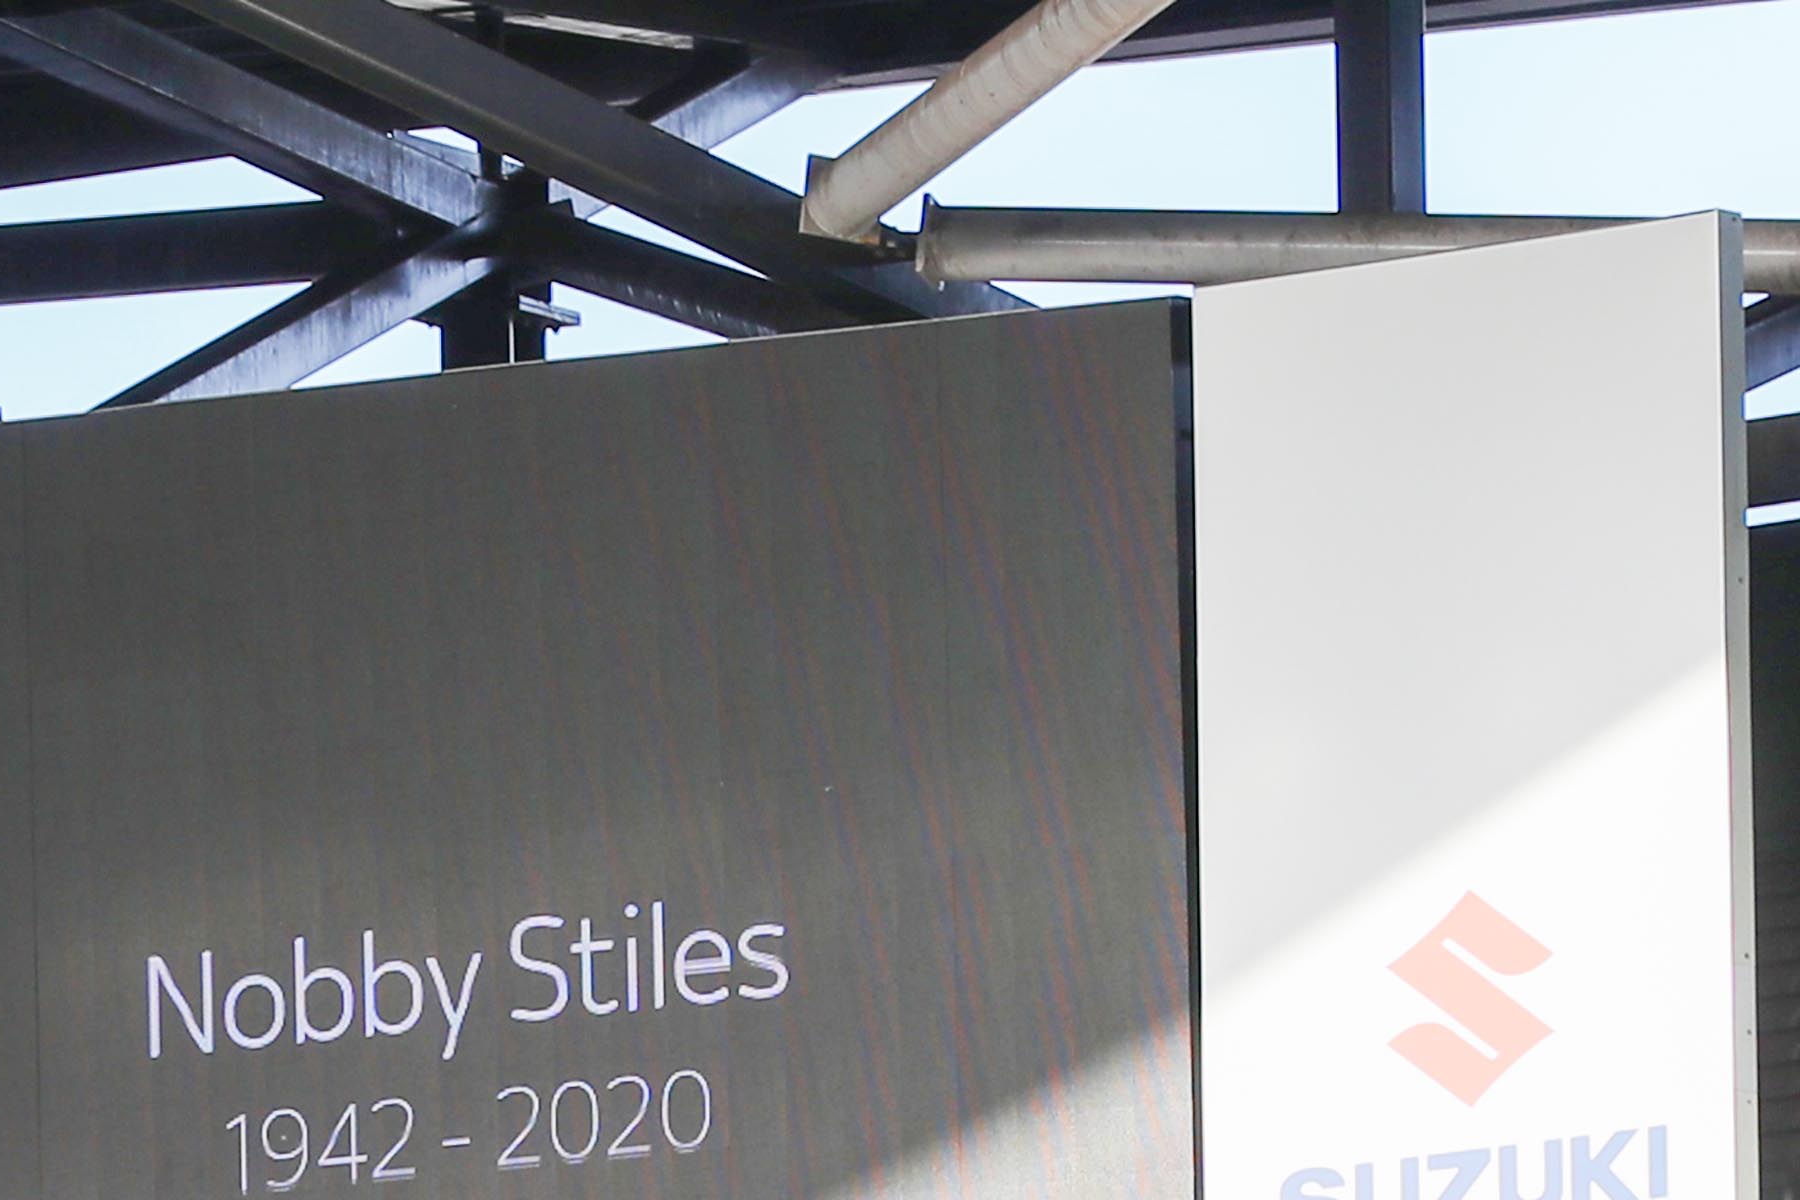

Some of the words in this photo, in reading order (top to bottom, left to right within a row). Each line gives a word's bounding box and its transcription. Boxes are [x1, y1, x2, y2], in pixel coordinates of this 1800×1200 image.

[147, 929, 483, 1060] Nobby
[509, 901, 790, 1022] Stiles
[226, 1097, 417, 1195] 1942
[496, 1068, 712, 1170] 2020
